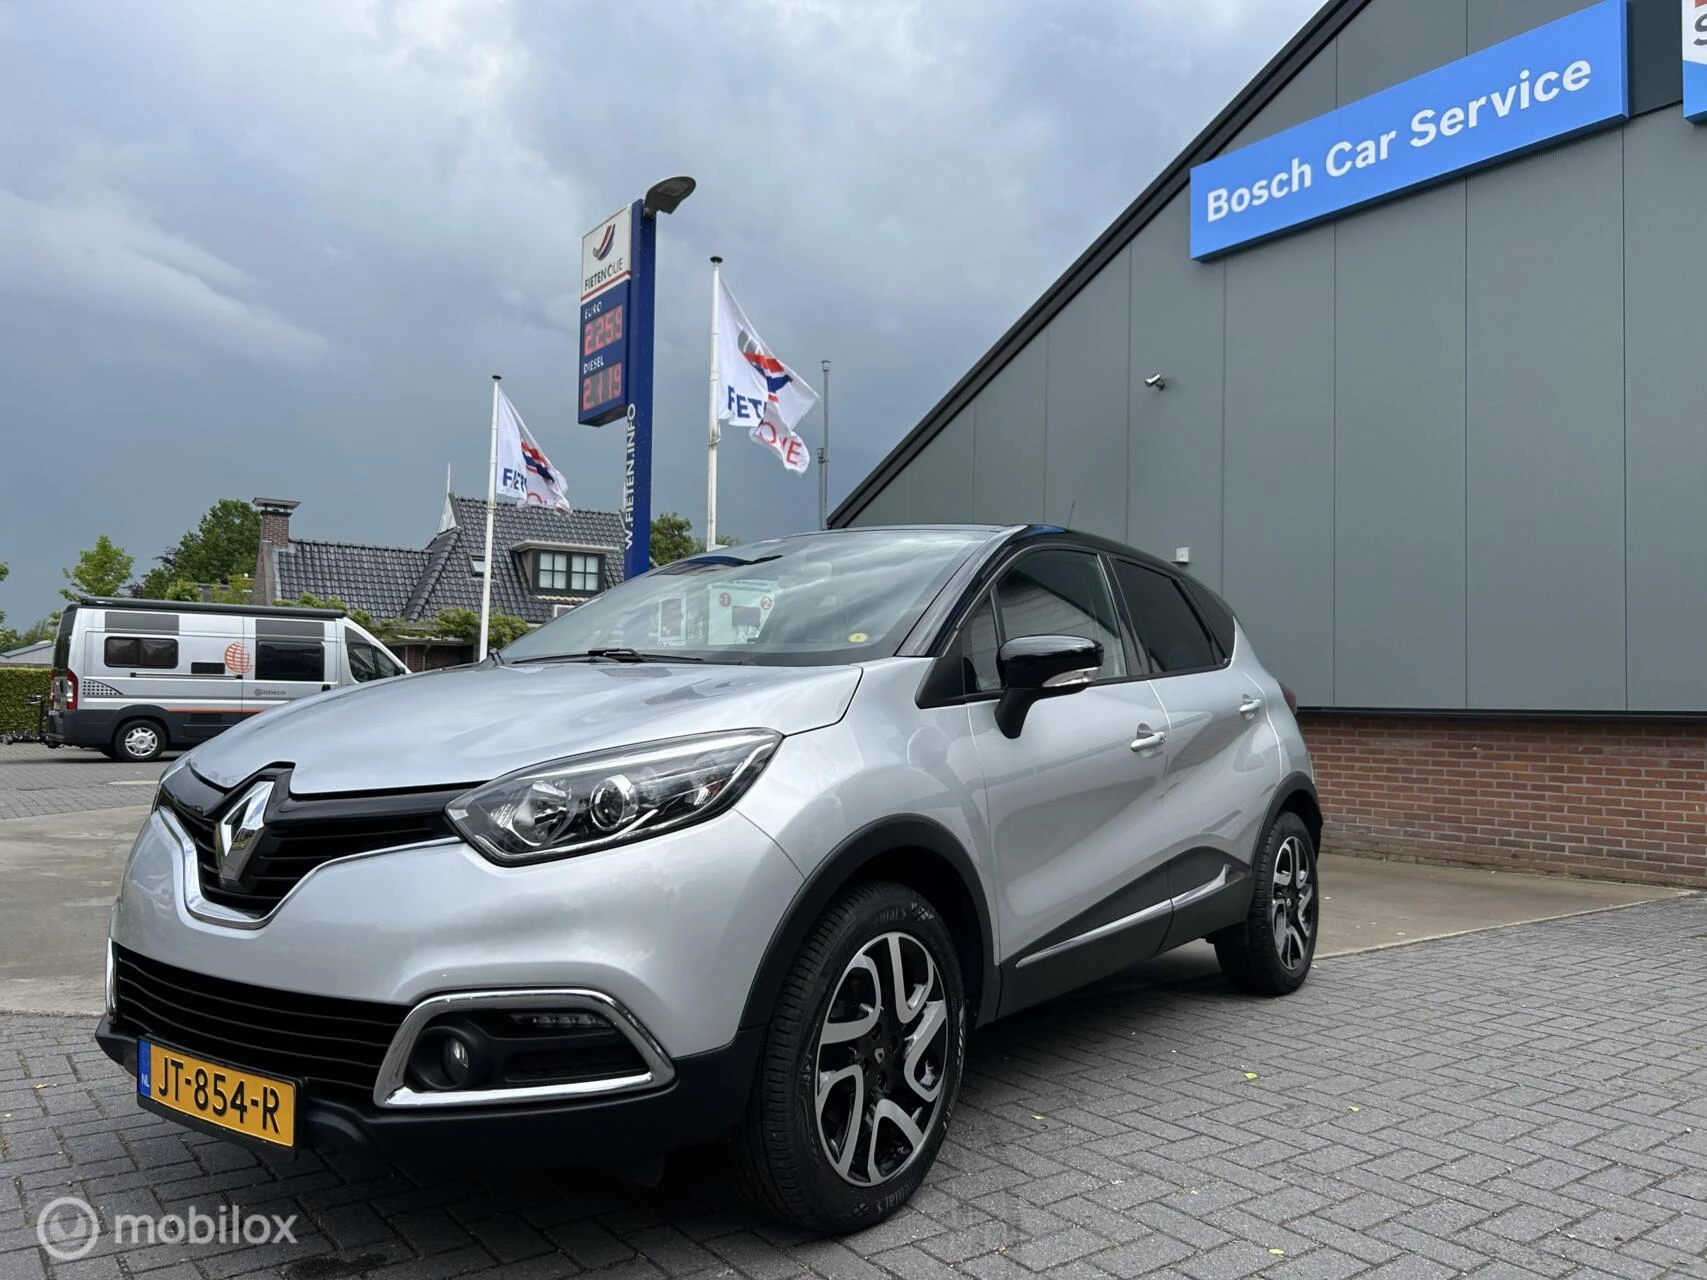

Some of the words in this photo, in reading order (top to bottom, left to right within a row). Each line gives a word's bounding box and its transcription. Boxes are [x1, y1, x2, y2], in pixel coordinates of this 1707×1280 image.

[1207, 157, 1312, 222] Bosch
[1325, 131, 1396, 177] Car
[1410, 59, 1592, 148] Service
[583, 355, 604, 374] DIESEL
[141, 1073, 150, 1088] NL
[158, 1056, 281, 1134] JT-854-R
